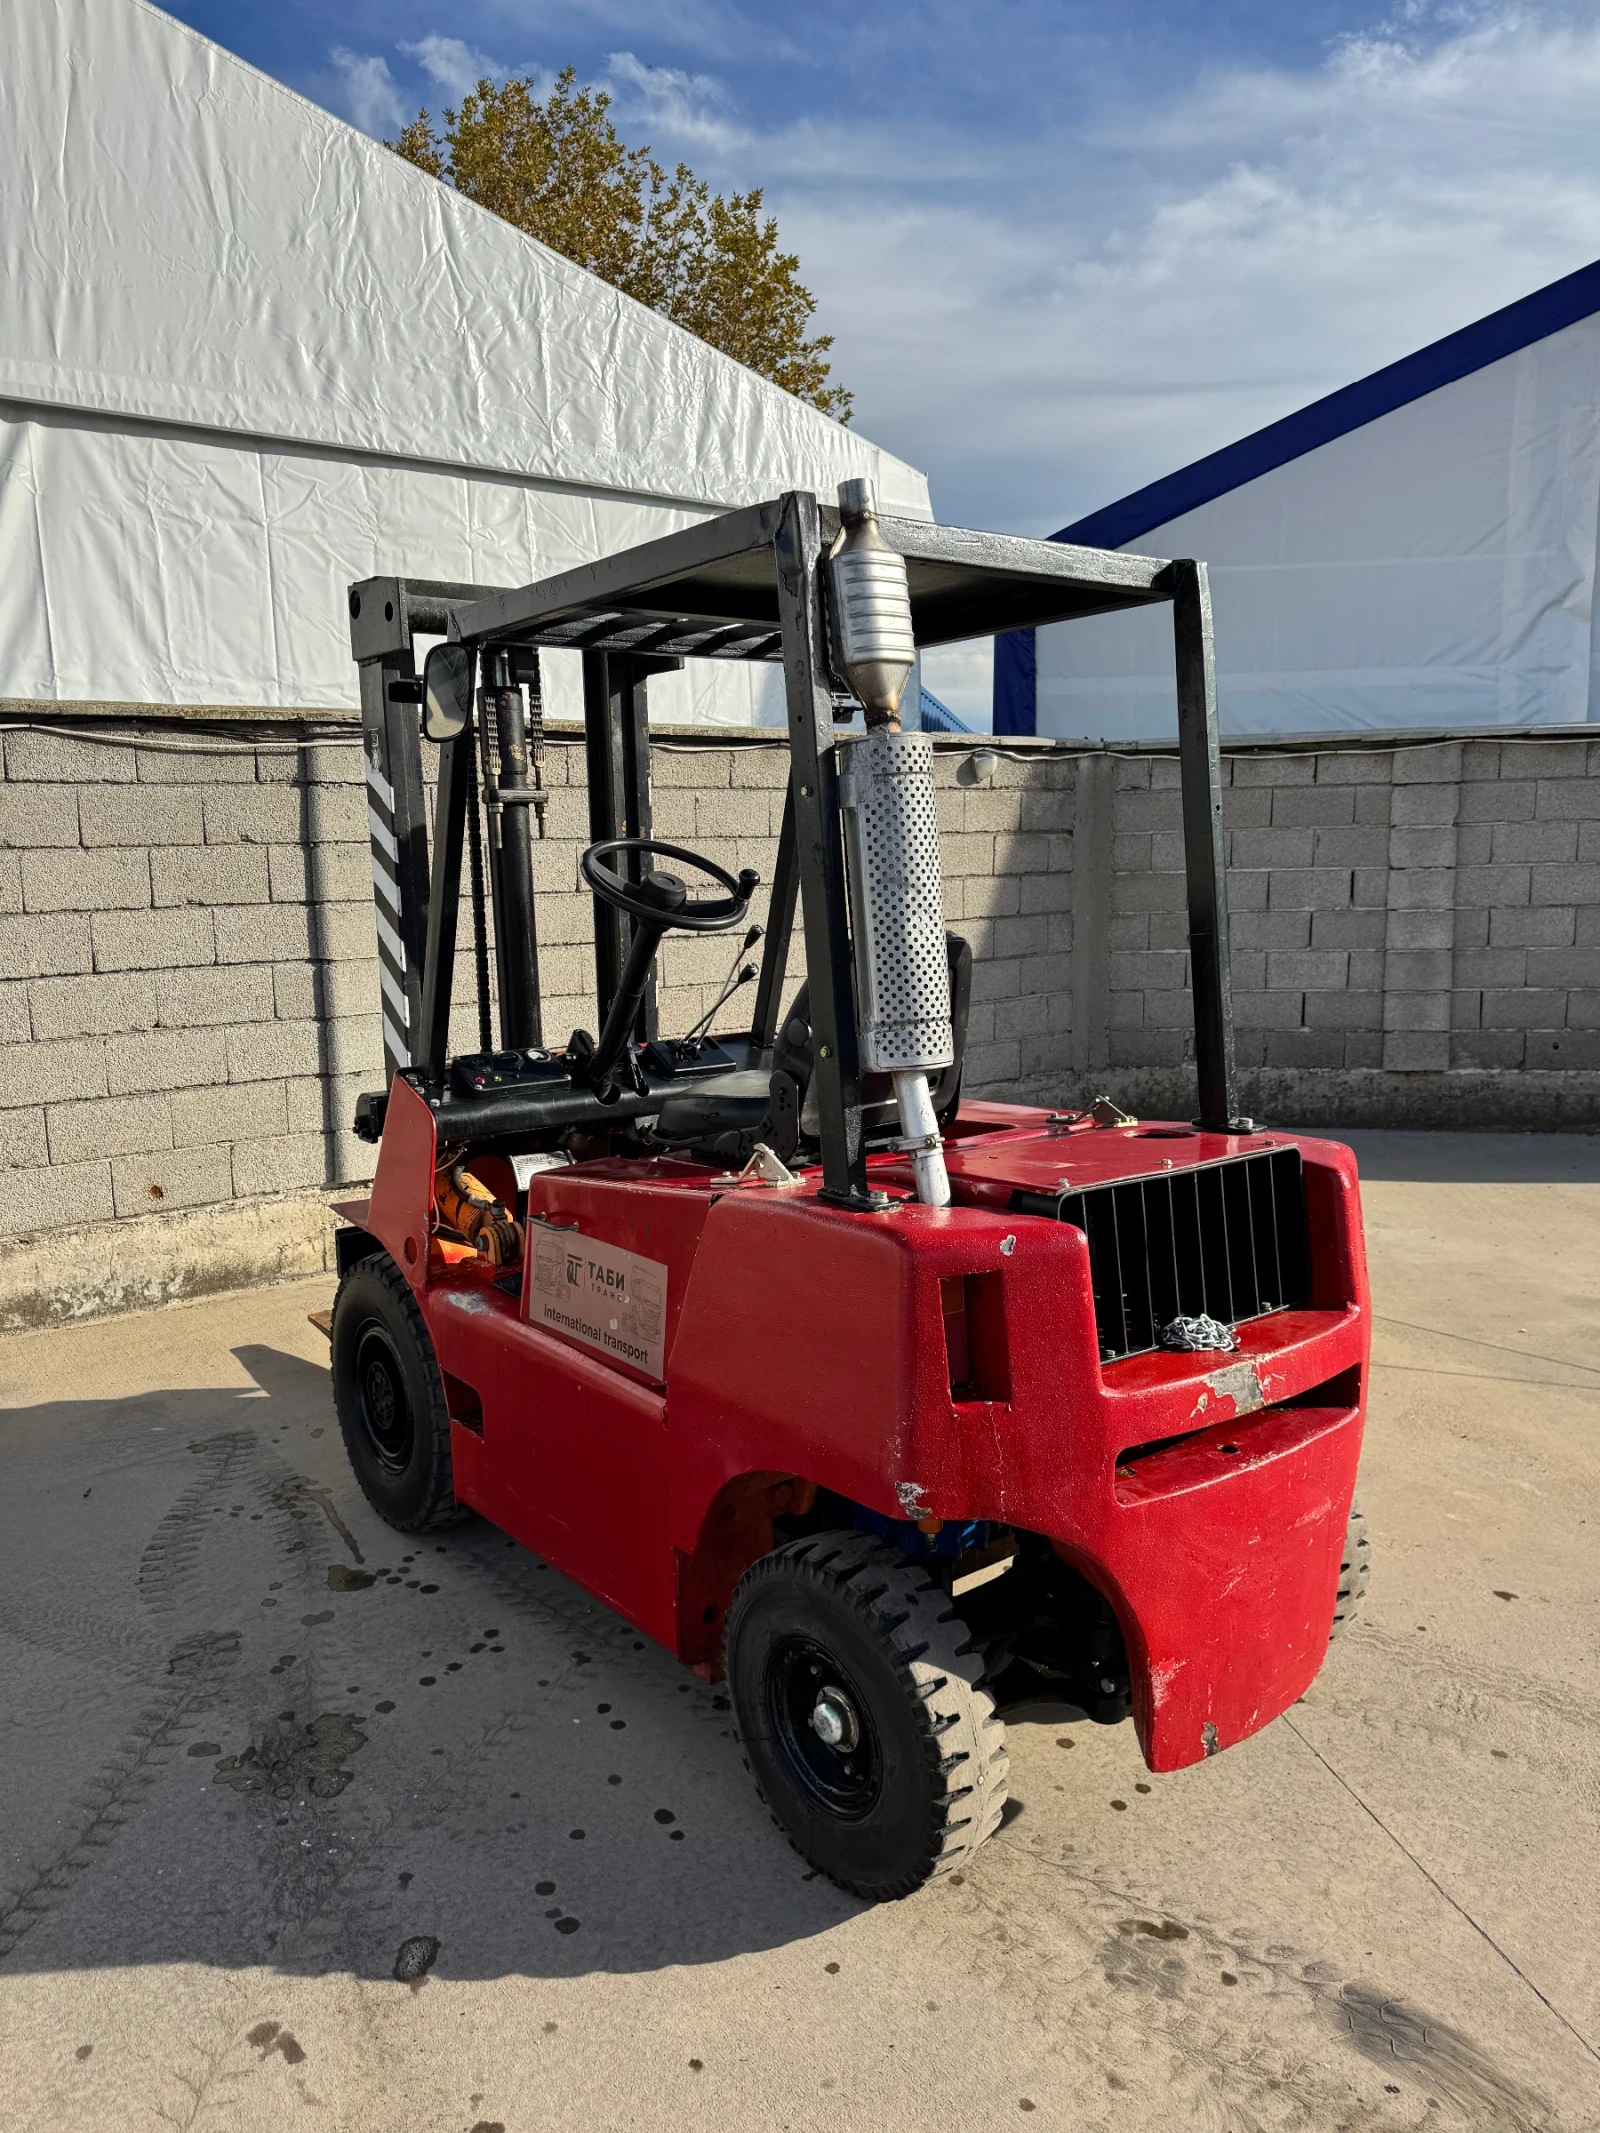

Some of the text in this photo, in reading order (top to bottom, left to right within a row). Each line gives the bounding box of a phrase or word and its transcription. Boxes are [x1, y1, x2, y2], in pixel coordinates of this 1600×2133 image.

[588, 1261, 625, 1292] ТАБИ
[591, 1283, 623, 1303] ТРАНС
[543, 1303, 649, 1364] international transport
